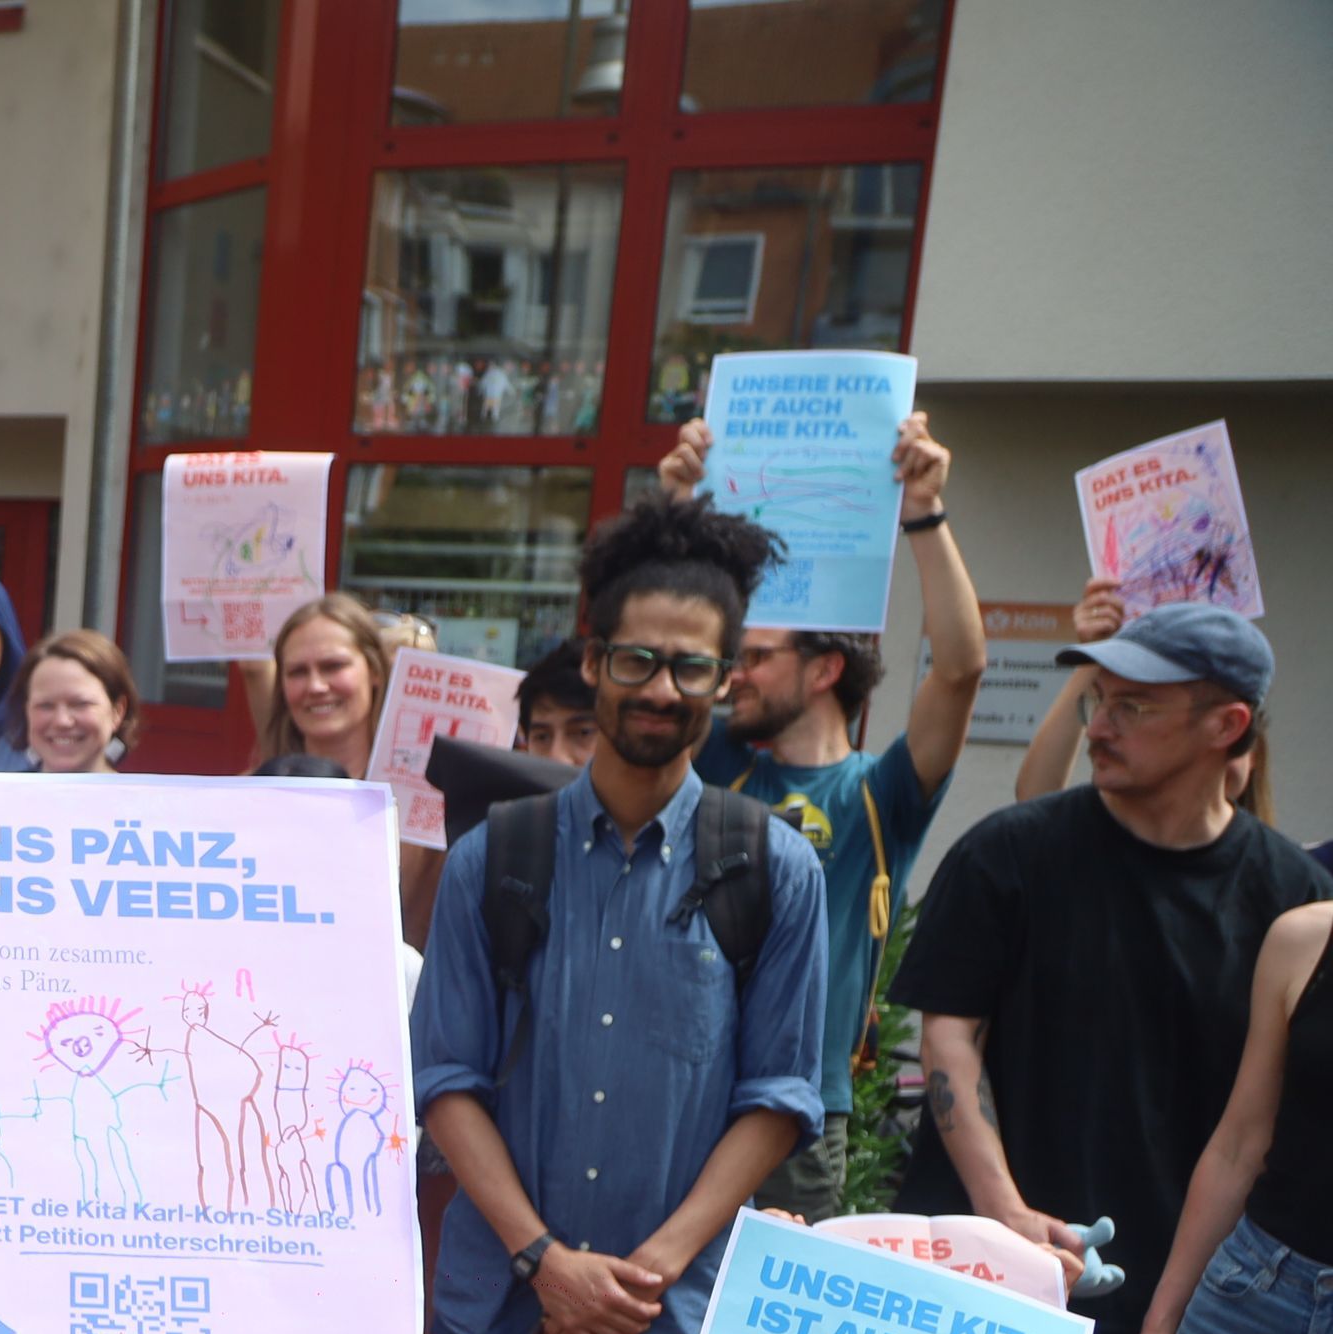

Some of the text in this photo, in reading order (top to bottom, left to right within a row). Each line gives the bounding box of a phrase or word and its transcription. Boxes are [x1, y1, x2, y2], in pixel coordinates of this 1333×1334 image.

[732, 375, 891, 393] UNSERE KITA
[729, 398, 843, 414] IST AUCH
[725, 420, 857, 439] EURE KITA.
[183, 469, 289, 487] UNS KITA.
[1092, 457, 1161, 493] DAT ES
[1094, 468, 1198, 511] UNS KITA.
[407, 663, 473, 688] DAT ES
[404, 683, 492, 713] UNS KITA.
[70, 820, 256, 879] PÄNZ,
[70, 878, 335, 924] VEEDEL.
[49, 944, 153, 966] zesamme.
[21, 969, 77, 994] Pänz.
[31, 1199, 68, 1218] die
[76, 1199, 127, 1220] Kita
[133, 1203, 356, 1230] Karl-Korn-Straße.
[19, 1223, 114, 1248] Petition
[123, 1230, 323, 1256] unterschreiben.
[759, 1255, 939, 1334] UNSERE
